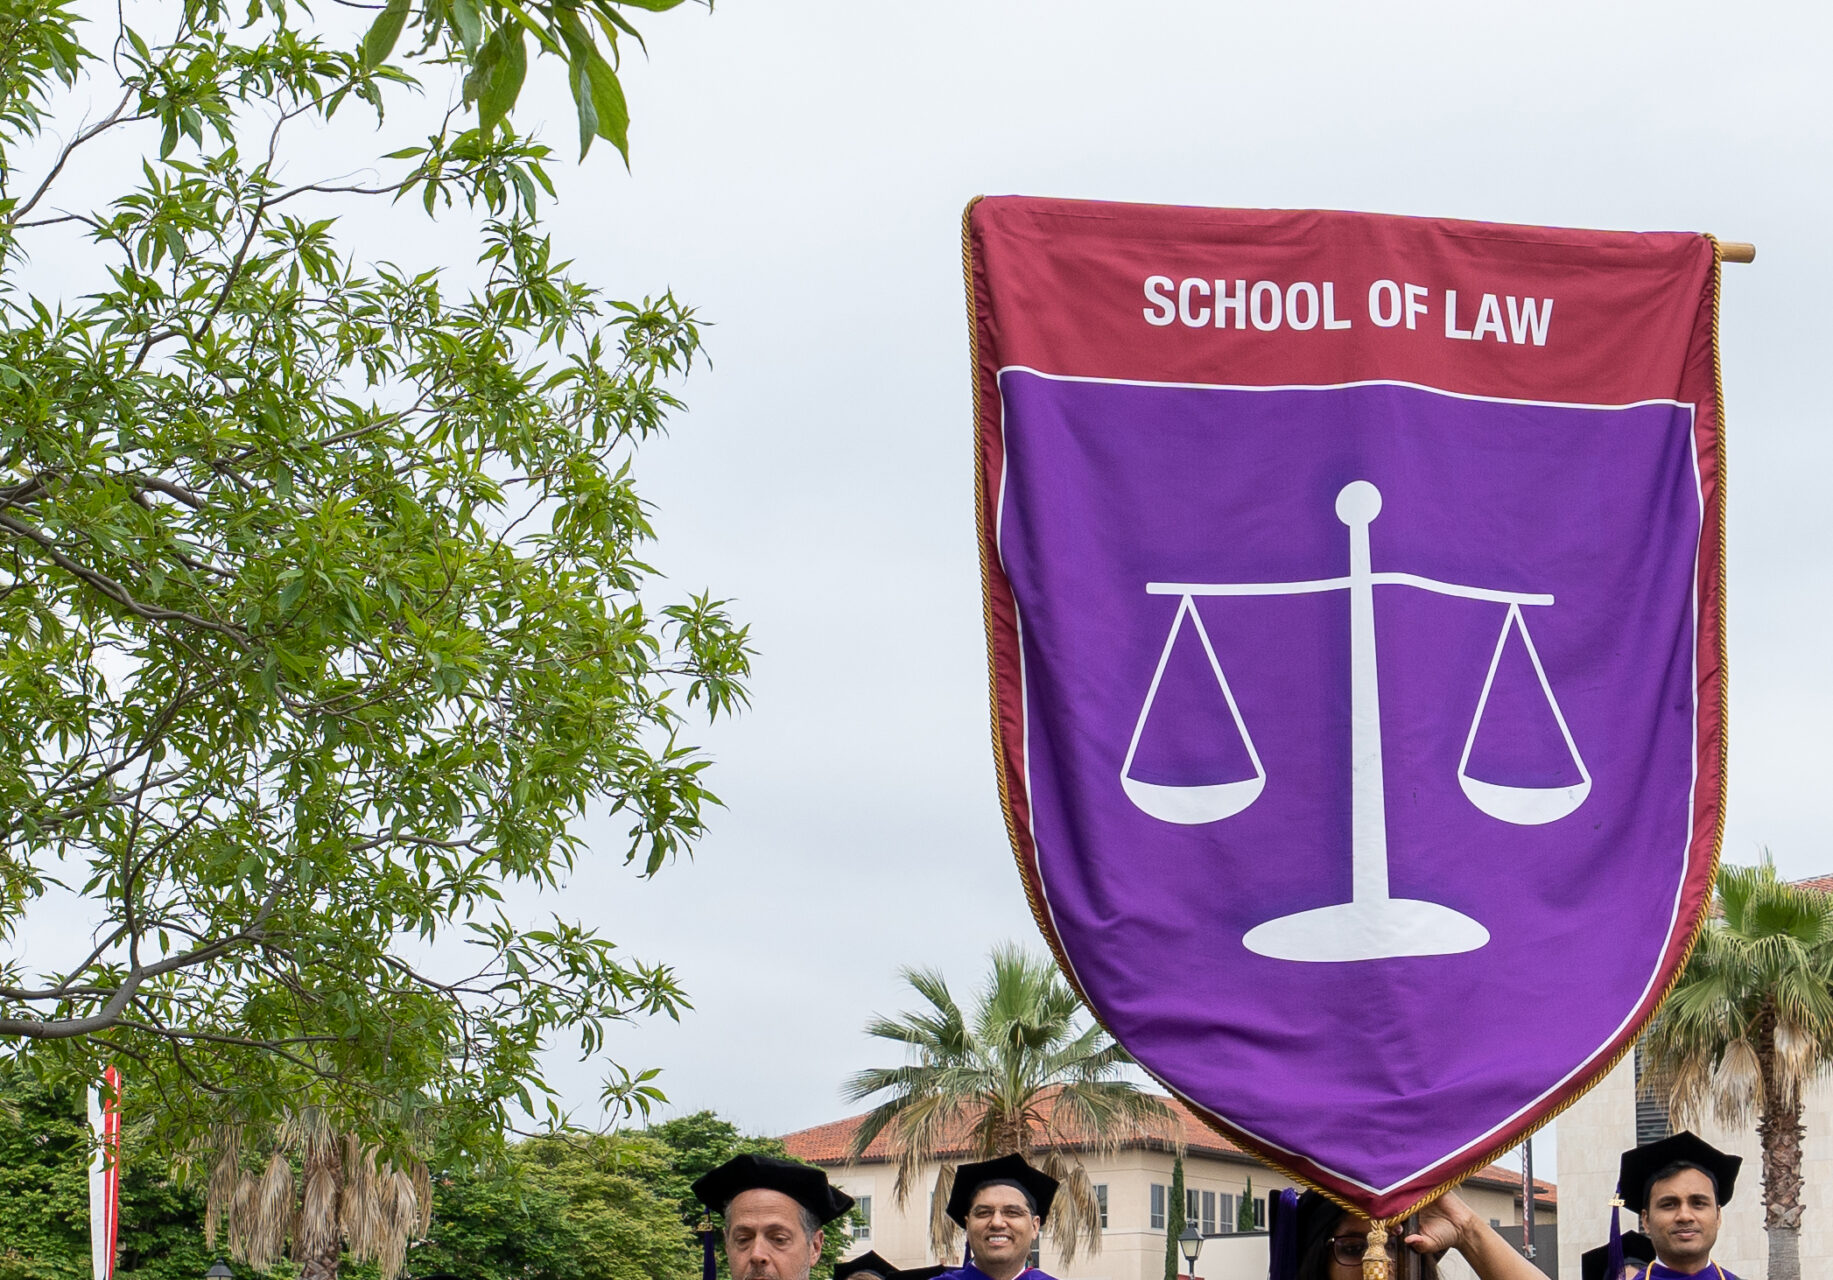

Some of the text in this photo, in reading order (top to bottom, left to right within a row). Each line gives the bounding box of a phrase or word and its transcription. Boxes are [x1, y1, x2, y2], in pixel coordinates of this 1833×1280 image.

[1143, 275, 1554, 346] SCHOOL OF LAW
